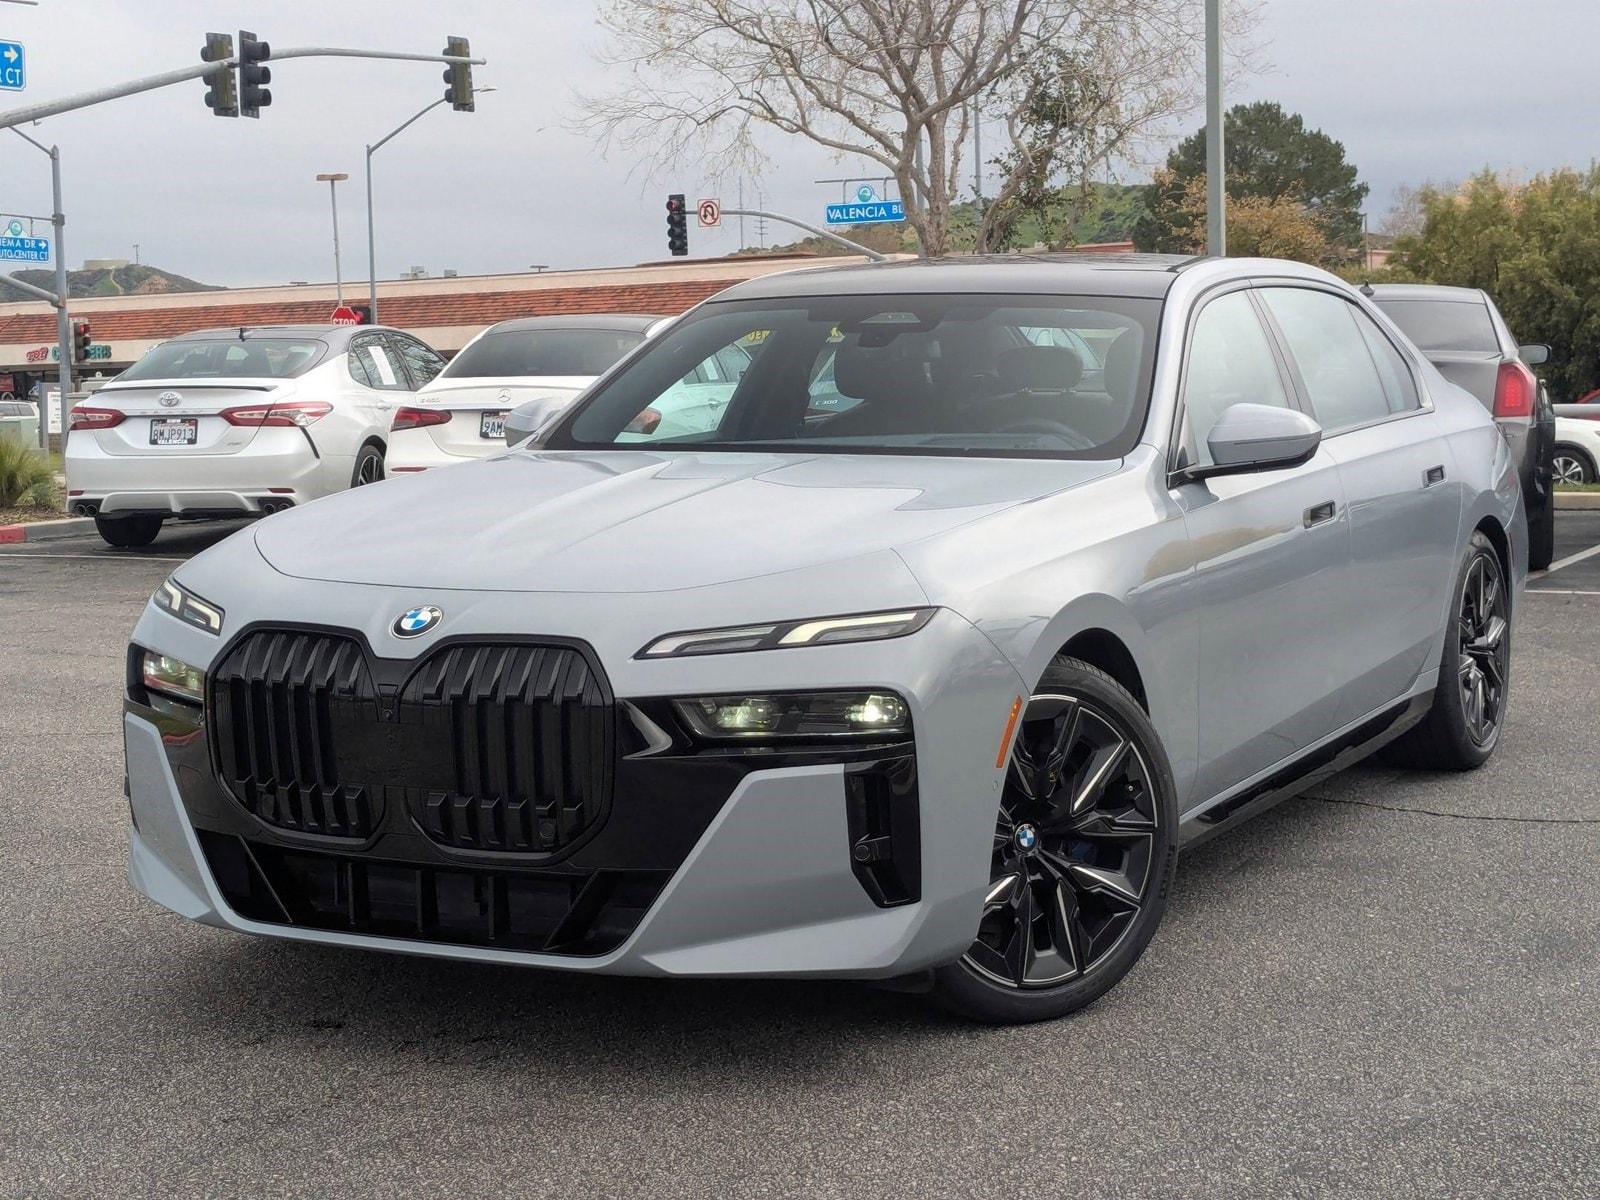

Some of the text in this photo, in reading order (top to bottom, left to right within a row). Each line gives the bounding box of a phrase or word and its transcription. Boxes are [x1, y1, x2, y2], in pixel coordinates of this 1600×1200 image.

[5, 67, 21, 85] CT
[828, 204, 904, 219] VALENCIA BL
[0, 237, 36, 249] EMA DR
[39, 251, 48, 261] CT
[484, 421, 505, 433] 9AM
